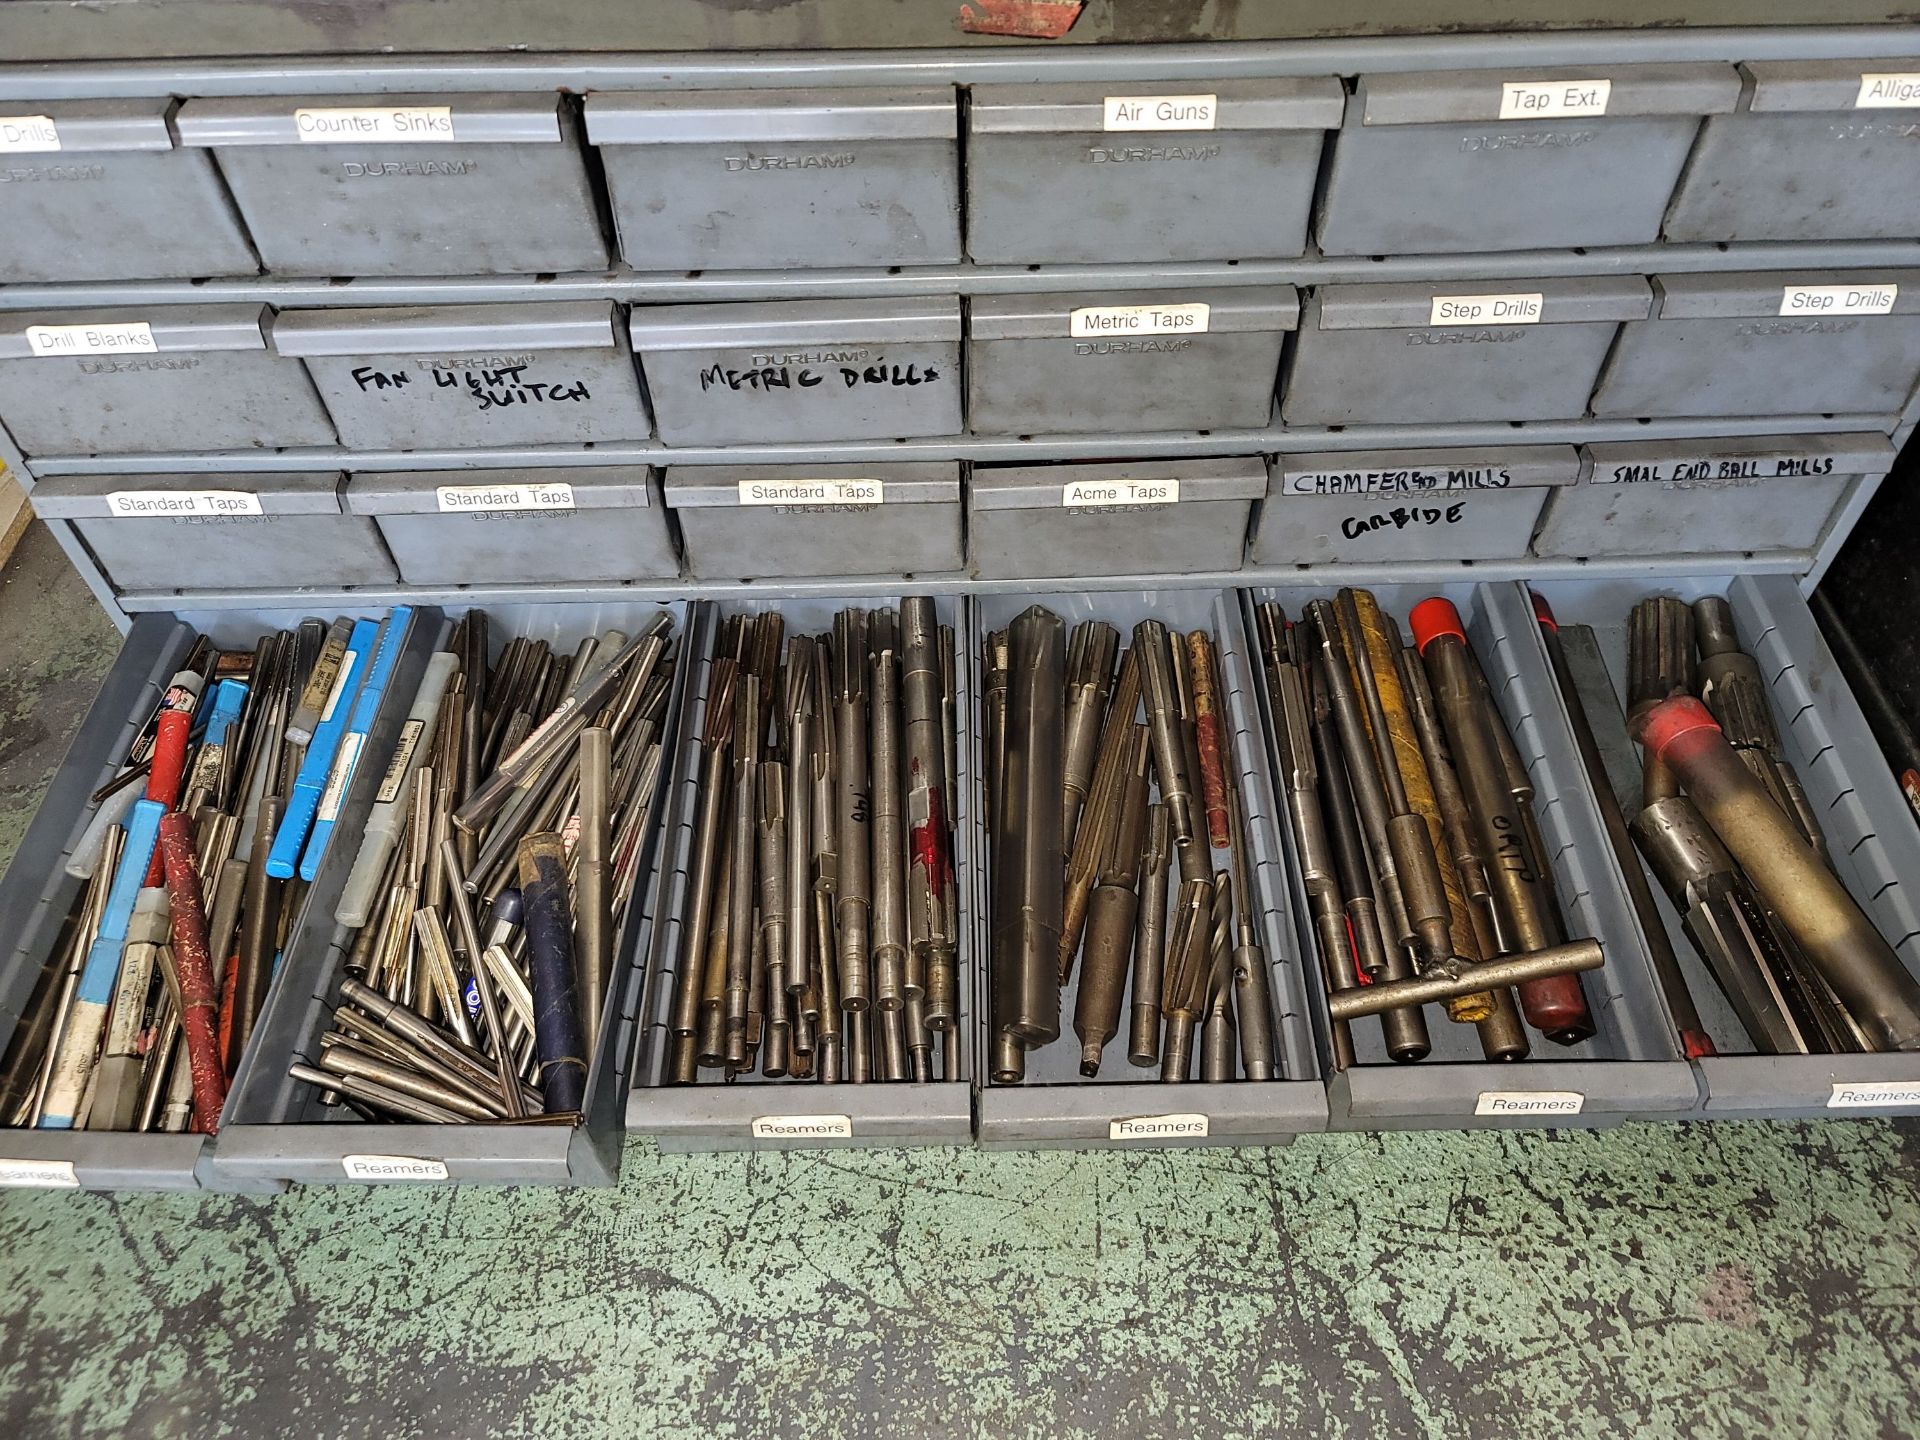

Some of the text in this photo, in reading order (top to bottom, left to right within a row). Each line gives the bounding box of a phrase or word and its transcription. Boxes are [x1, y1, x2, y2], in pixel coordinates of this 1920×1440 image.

[1513, 88, 1600, 113] Tap Ext.
[1116, 102, 1210, 121] Air Guns
[299, 112, 451, 134] Counter Sinks
[3, 124, 57, 143] Drills
[1440, 299, 1538, 321] Step Drills
[1791, 290, 1891, 313] Step Drills
[1085, 311, 1194, 331] Metric Taps
[39, 328, 150, 348] Drill Blanks
[351, 366, 412, 392] FAN
[700, 363, 823, 392] METRIC
[1447, 468, 1511, 489] MILLS
[1610, 465, 1662, 483] SMAL
[1672, 461, 1712, 481] END
[1718, 461, 1762, 479] BALL
[445, 488, 570, 509] Standard Taps
[752, 483, 875, 502] Standard Taps
[1071, 483, 1167, 502] Acme Taps
[118, 496, 247, 515] Standard Taps
[1493, 1099, 1577, 1111] Reamers
[1840, 1090, 1920, 1102] Reamers
[760, 1123, 845, 1135] Reamers
[1120, 1120, 1204, 1134] Reamers
[354, 1160, 442, 1176] Reamers
